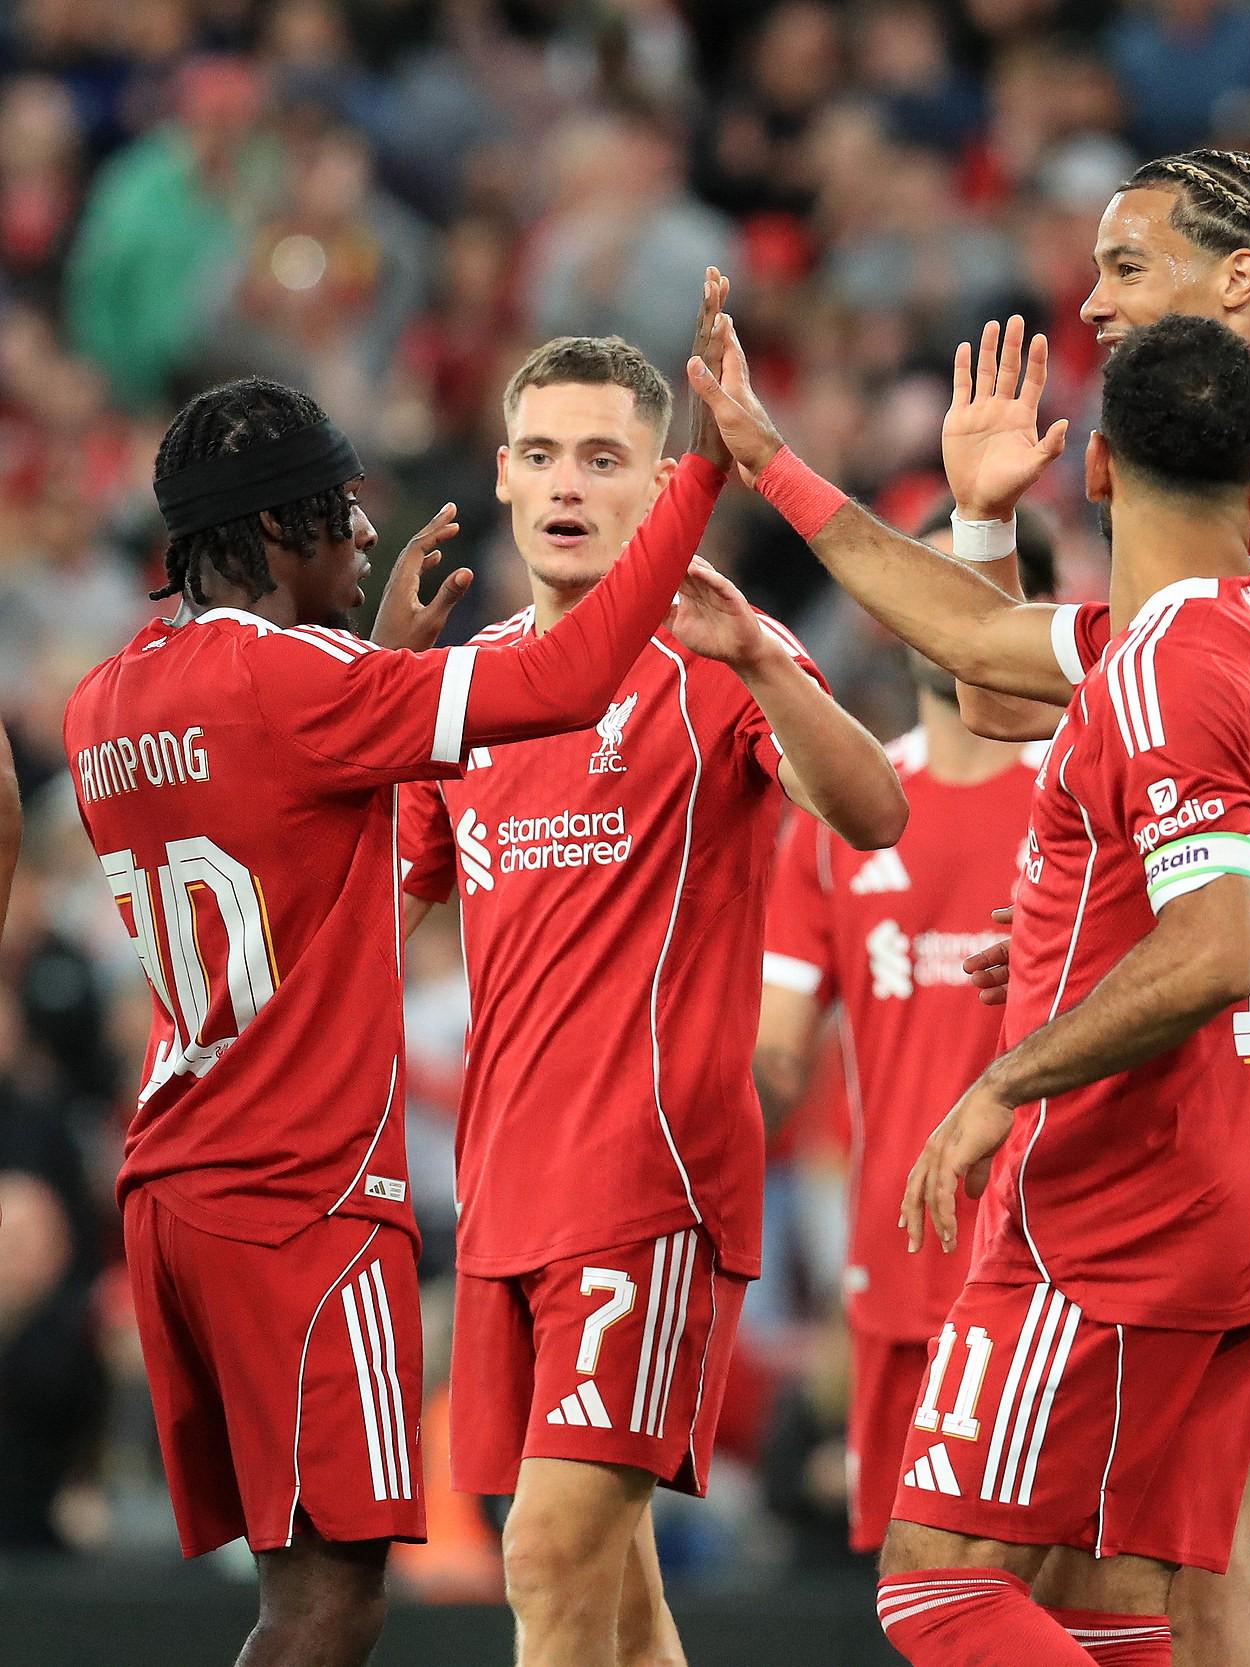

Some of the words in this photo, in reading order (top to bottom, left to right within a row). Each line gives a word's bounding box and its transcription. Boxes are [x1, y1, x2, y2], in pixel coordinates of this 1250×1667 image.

[588, 754, 629, 775] L.F.C.
[497, 806, 625, 846] standard
[1133, 798, 1225, 855] xpedia
[499, 834, 633, 874] chartered
[1146, 845, 1209, 886] ptain
[574, 1266, 638, 1376] 7
[914, 1322, 994, 1442] 11
